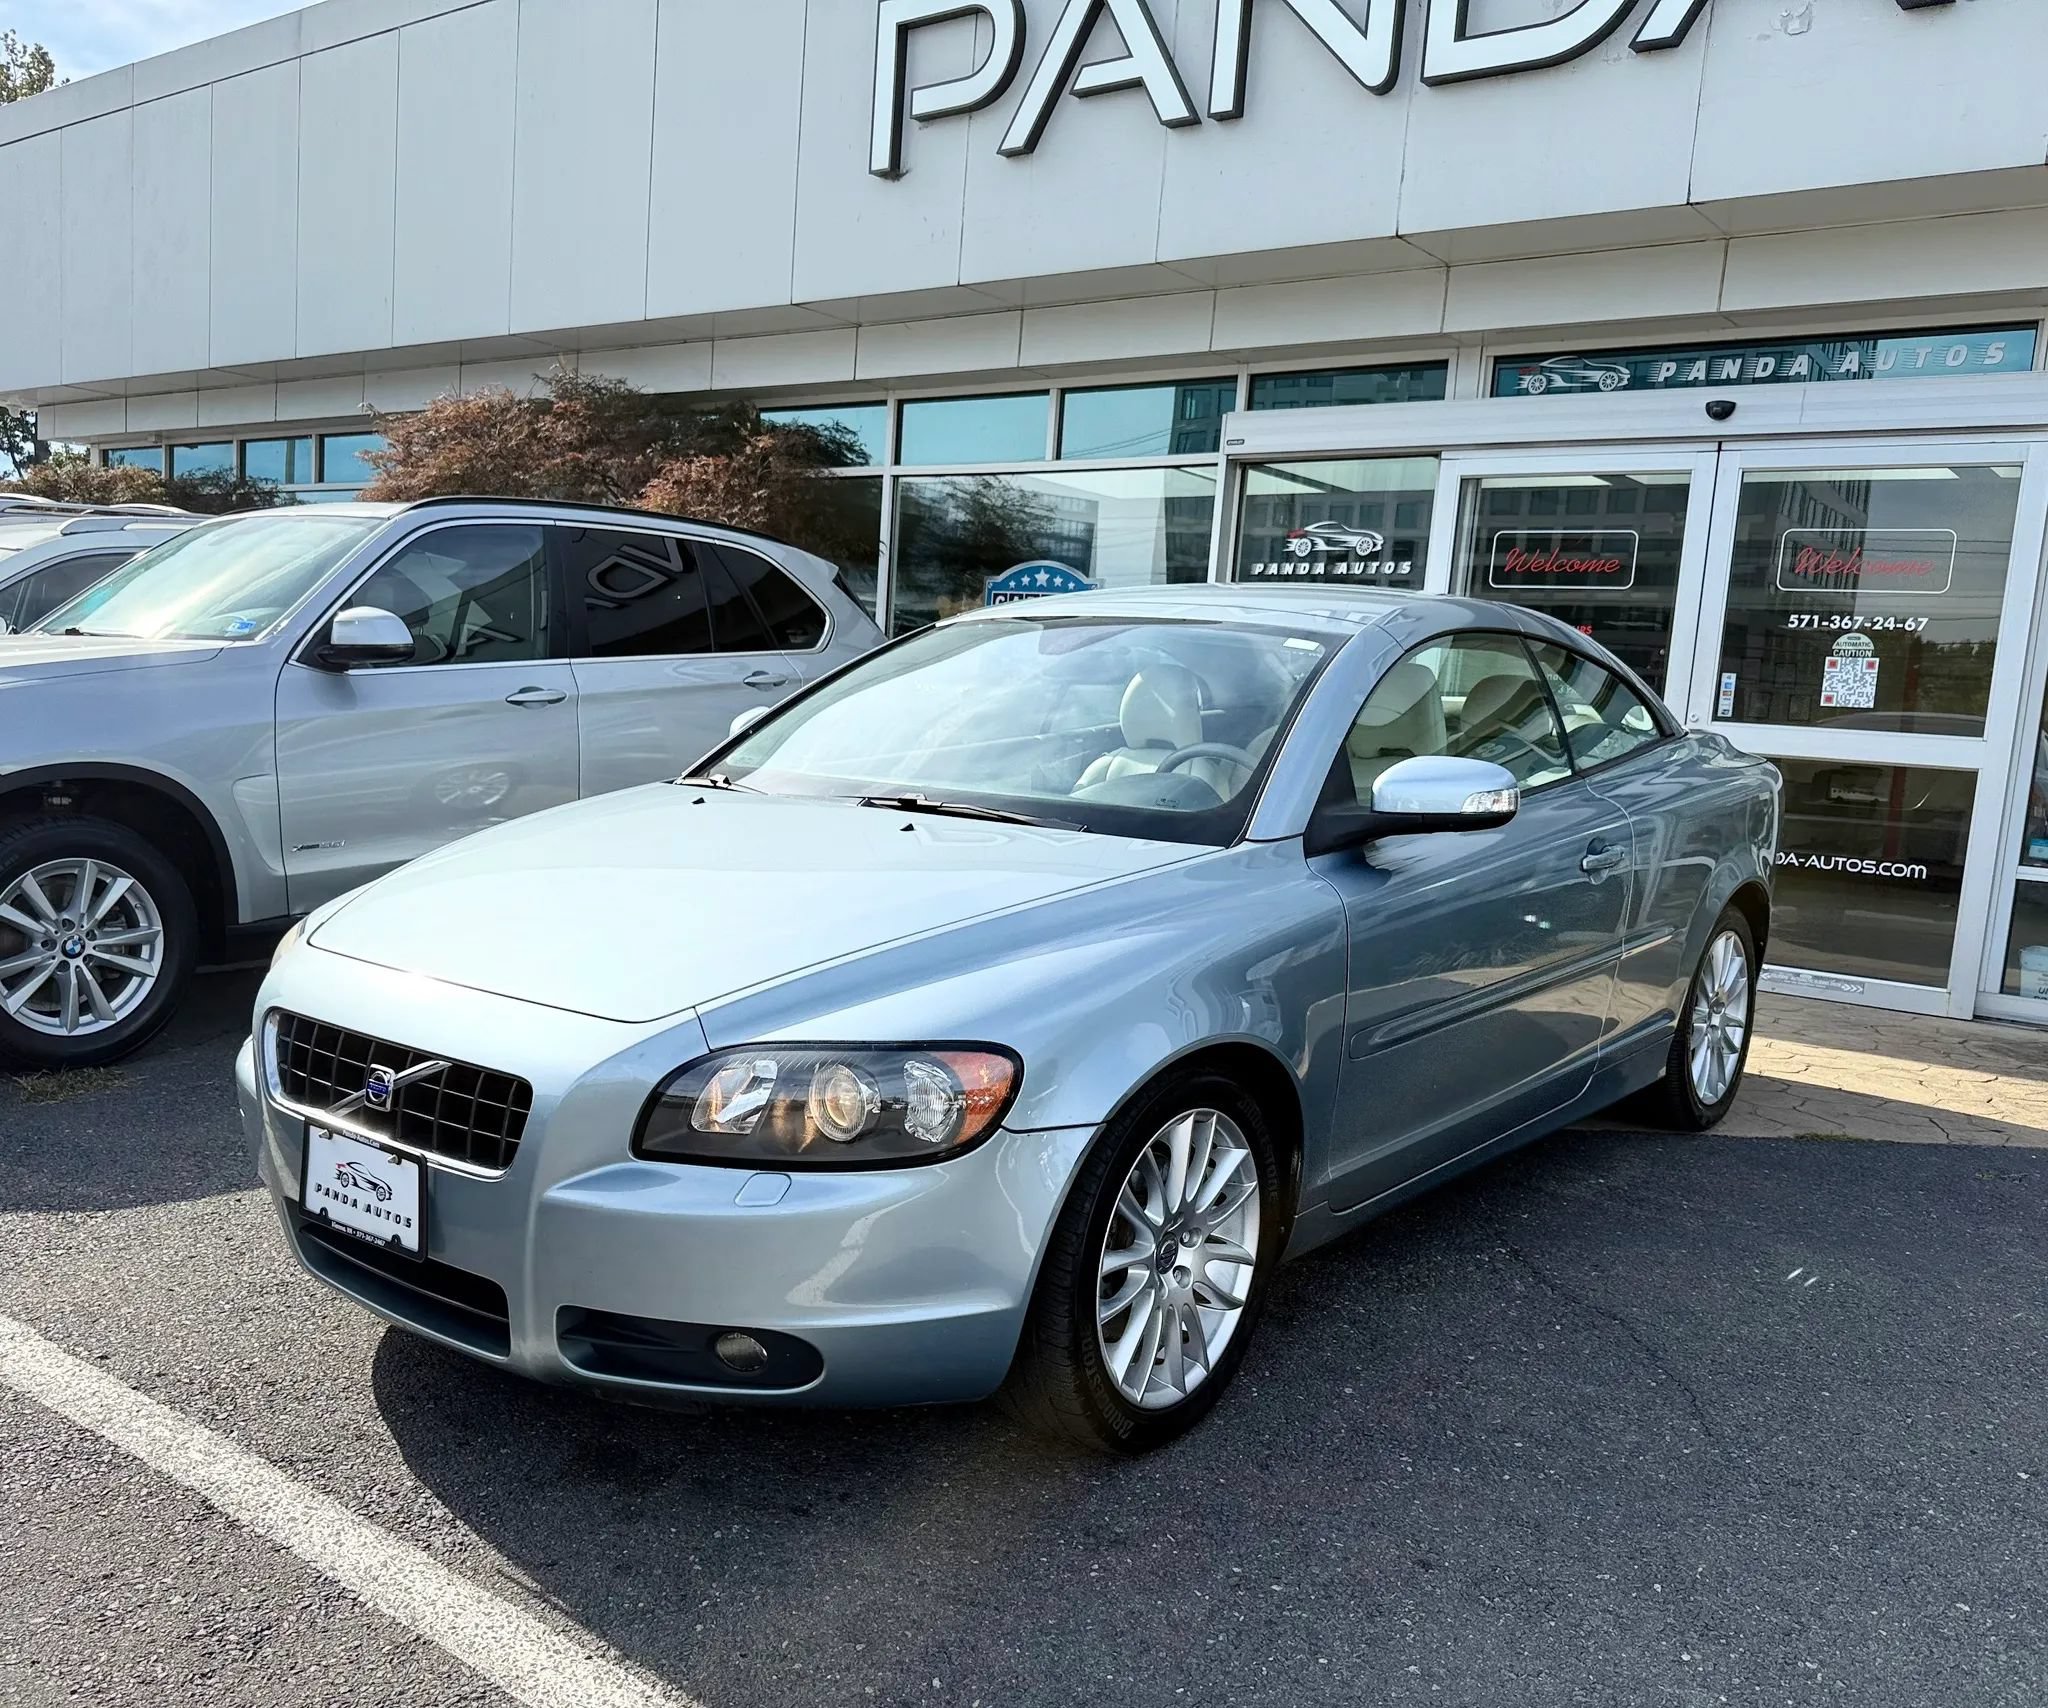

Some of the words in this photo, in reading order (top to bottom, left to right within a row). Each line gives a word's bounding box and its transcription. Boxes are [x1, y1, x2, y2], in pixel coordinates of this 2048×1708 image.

[869, 0, 1957, 181] PAN
[1648, 354, 1809, 382] PANDA
[1829, 342, 2006, 373] AUTOS
[1251, 562, 1325, 576] PANDA
[1332, 561, 1412, 575] AUTOS
[1504, 547, 1621, 574] Welcome
[1795, 547, 1936, 575] Welcome
[1788, 614, 1929, 631] 571-367-24-67
[314, 1182, 358, 1209] PANDA
[362, 1203, 412, 1229] AUTOS
